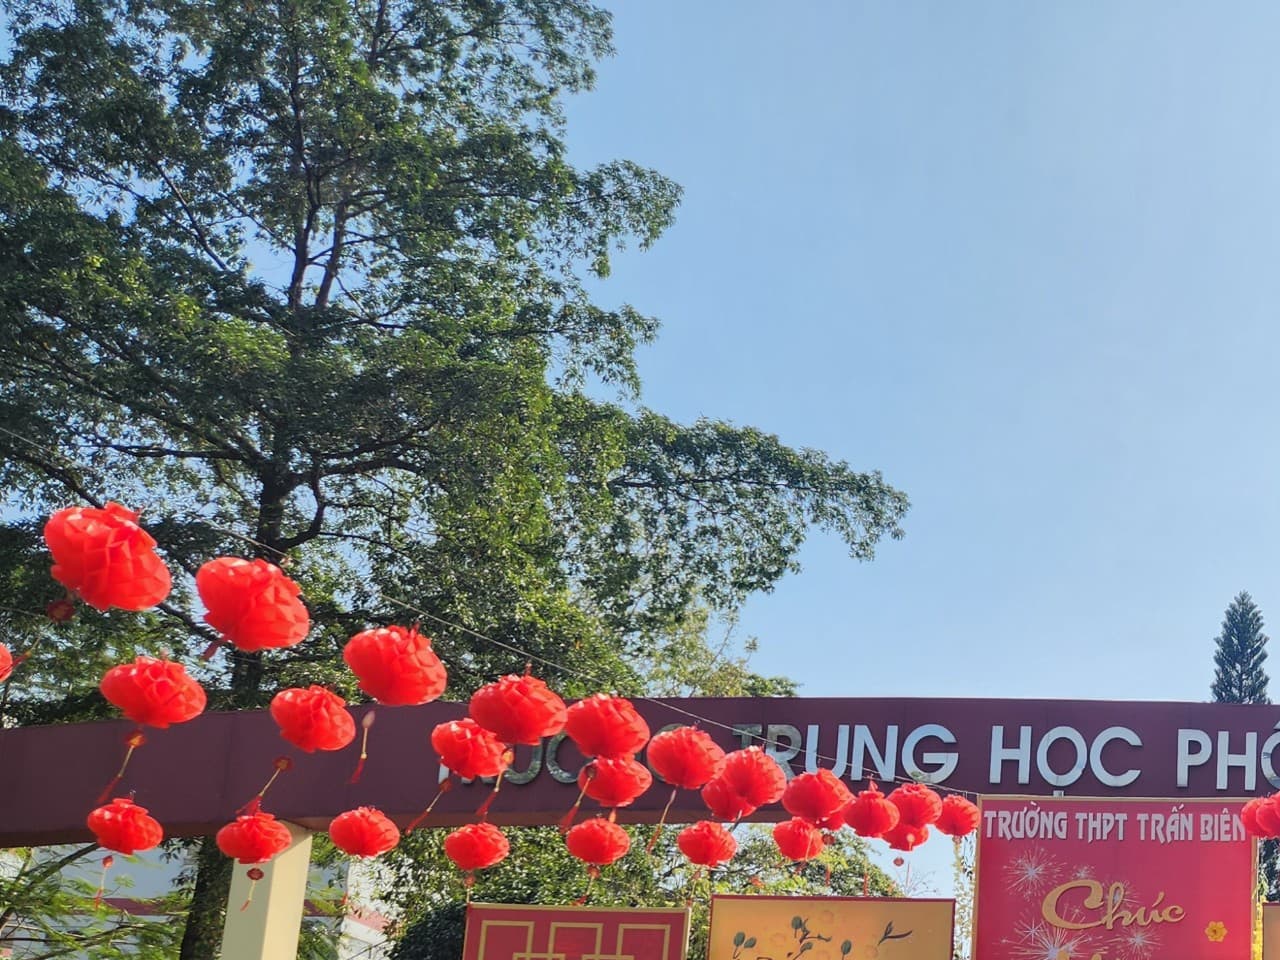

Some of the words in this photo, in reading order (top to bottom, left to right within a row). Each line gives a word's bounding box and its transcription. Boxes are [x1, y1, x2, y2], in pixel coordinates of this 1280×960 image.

[732, 723, 959, 784] TRUNG
[989, 724, 1142, 797] HỌC
[983, 801, 1068, 841] TRƯỜNG
[1075, 812, 1128, 843] THPT
[1136, 803, 1194, 844] TRẤN
[1200, 807, 1246, 843] BIÊN
[1041, 879, 1186, 930] Chúc
